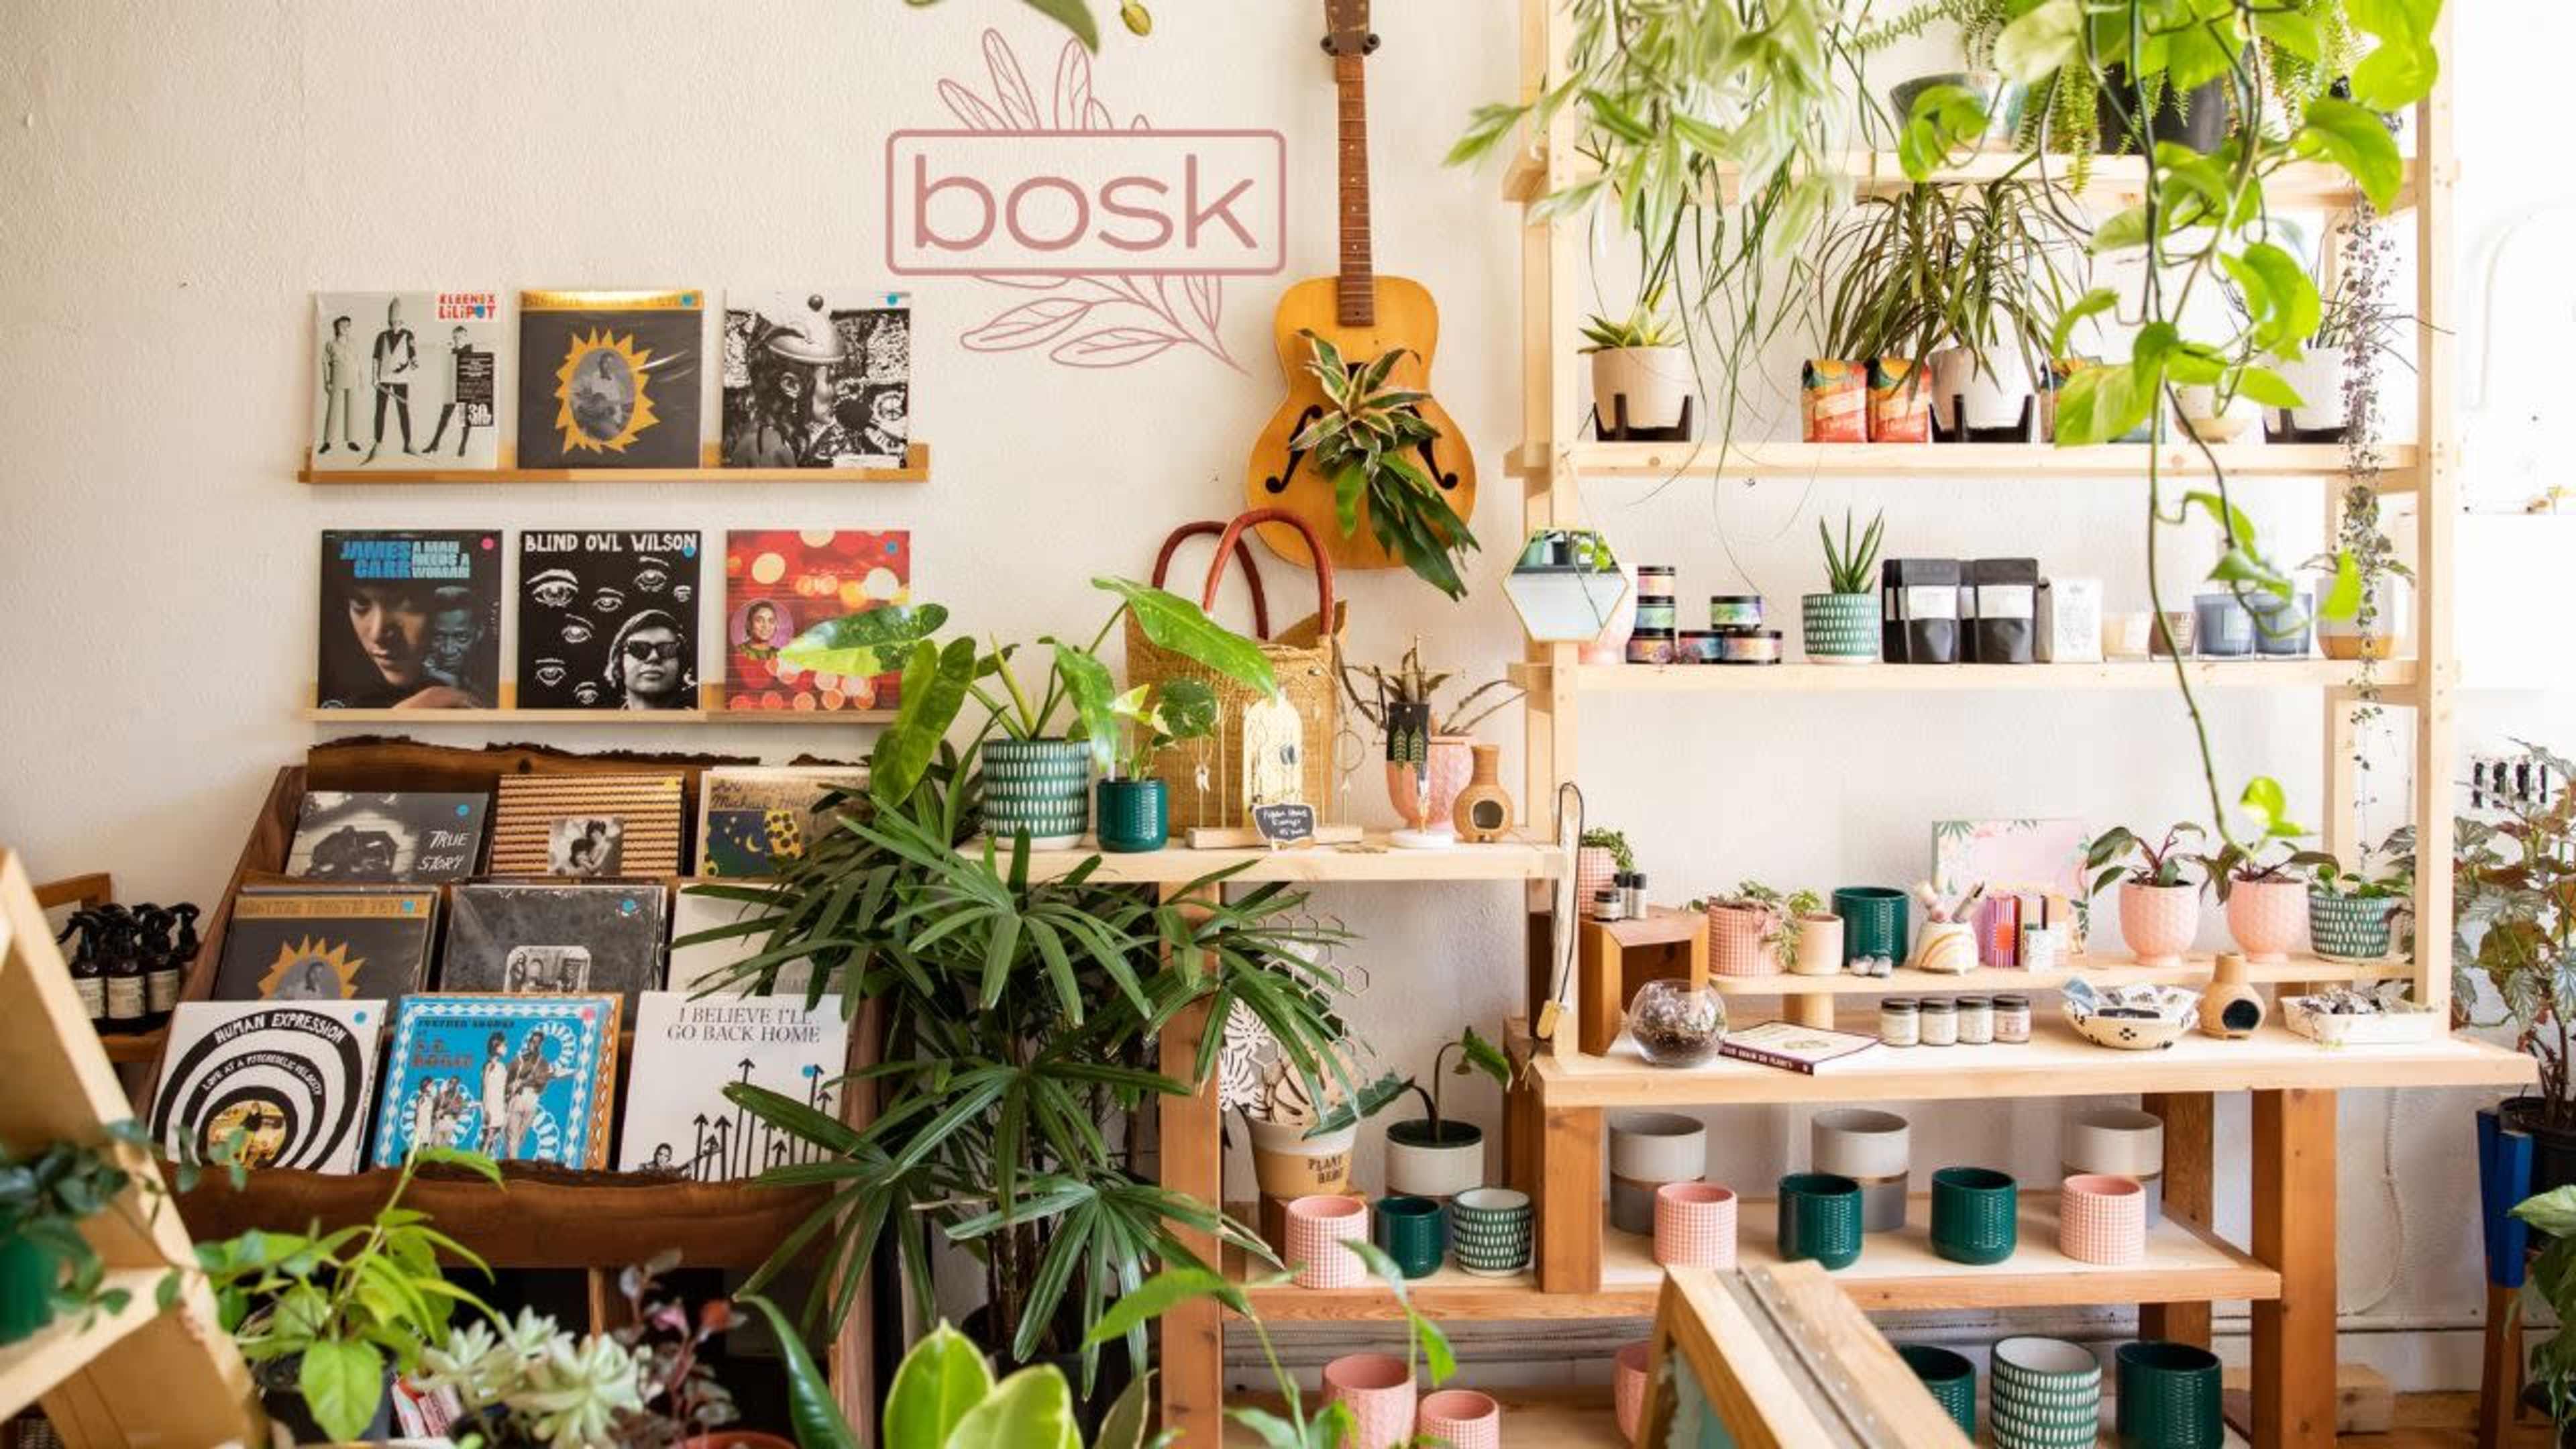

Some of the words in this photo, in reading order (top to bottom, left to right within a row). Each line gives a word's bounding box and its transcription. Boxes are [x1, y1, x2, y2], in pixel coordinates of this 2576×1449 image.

[914, 154, 1258, 252] bosk
[439, 305, 496, 319] LiLiPT
[340, 541, 411, 560] JAMES
[525, 534, 578, 552] BLIND
[585, 533, 623, 552] OWL
[631, 533, 697, 553] WILSON
[354, 559, 411, 578] CARR
[430, 830, 471, 849] TRUE
[418, 854, 465, 873] STORY
[679, 1008, 686, 1023] I
[692, 1008, 771, 1023] BELIEVE
[778, 1008, 812, 1024] I'LL
[214, 1014, 265, 1044] HUMAN
[667, 1025, 696, 1040] GO
[703, 1025, 755, 1041] BACK
[761, 1026, 820, 1043] HOME
